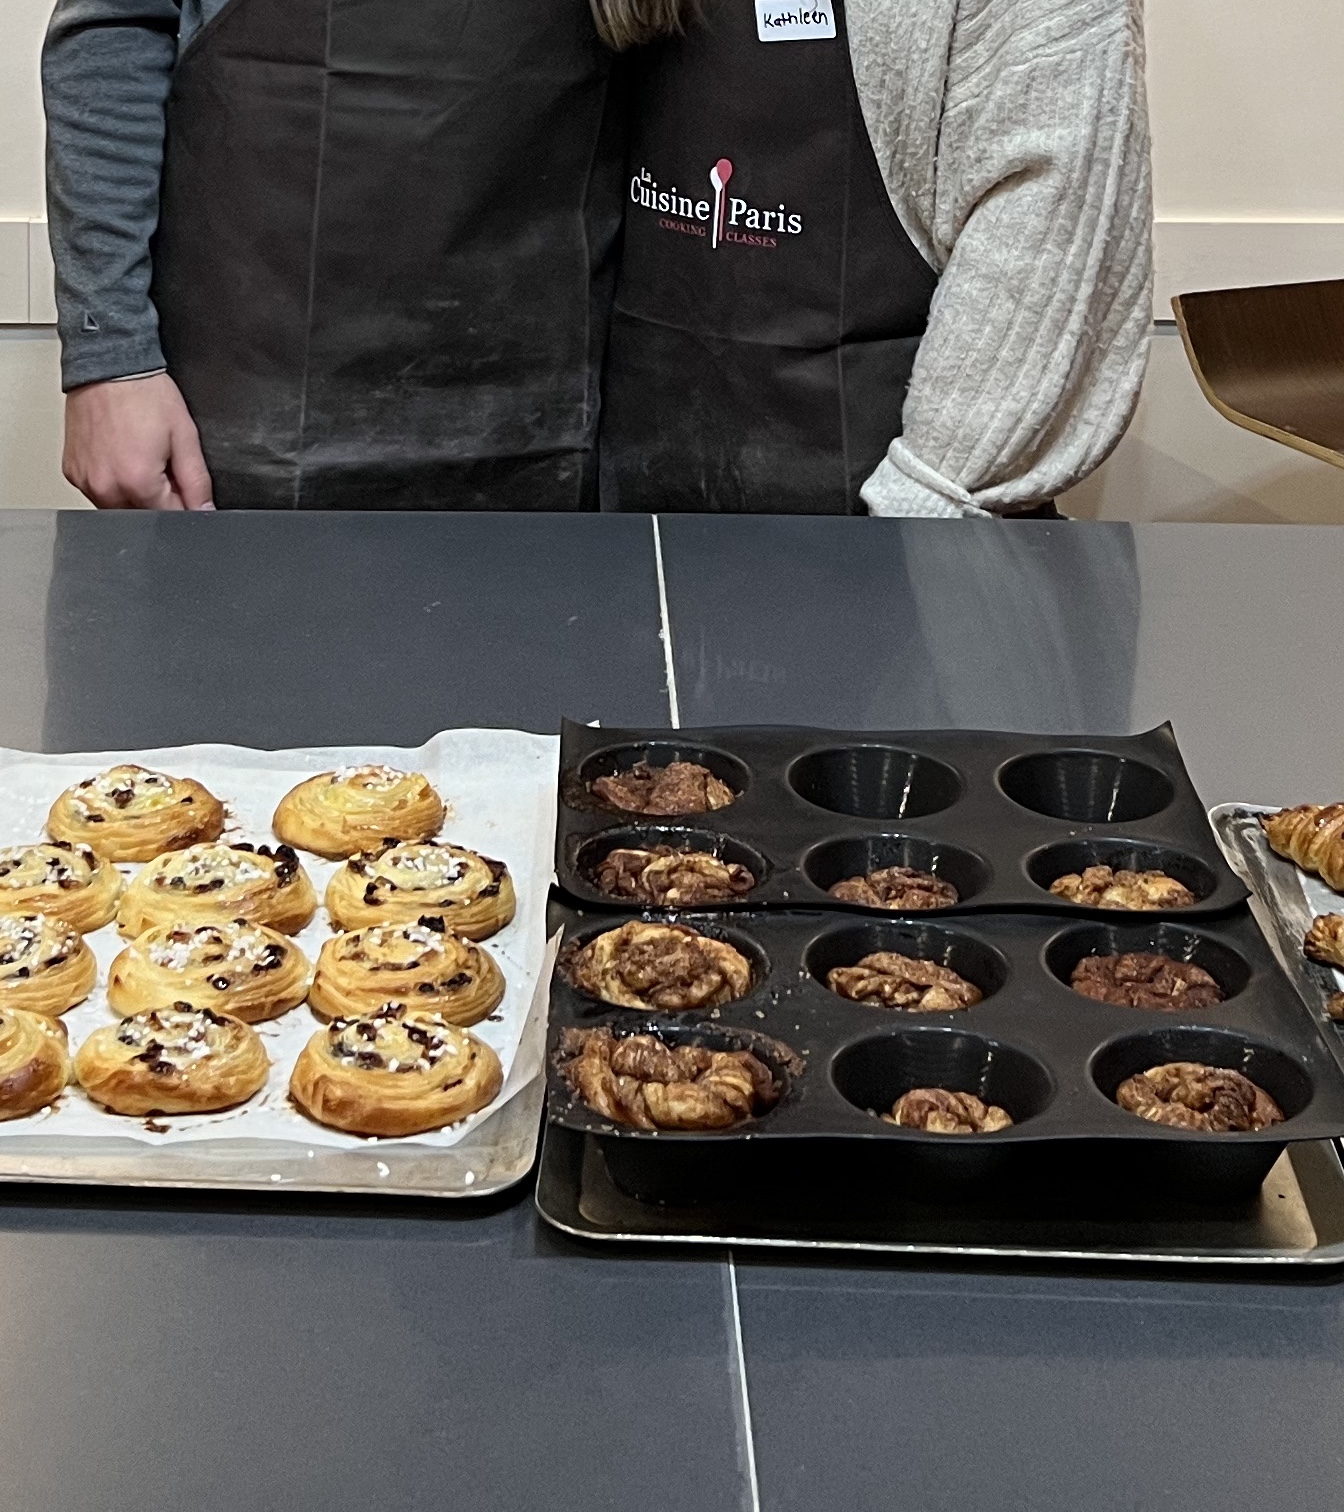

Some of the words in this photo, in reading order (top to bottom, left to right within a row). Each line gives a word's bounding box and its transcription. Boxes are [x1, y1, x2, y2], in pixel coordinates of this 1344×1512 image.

[763, 7, 828, 29] Kathleen
[640, 167, 651, 183] La
[630, 176, 710, 220] Cuisine
[728, 197, 802, 234] Paris
[658, 218, 706, 237] COOKING
[726, 231, 777, 248] CLASSES
